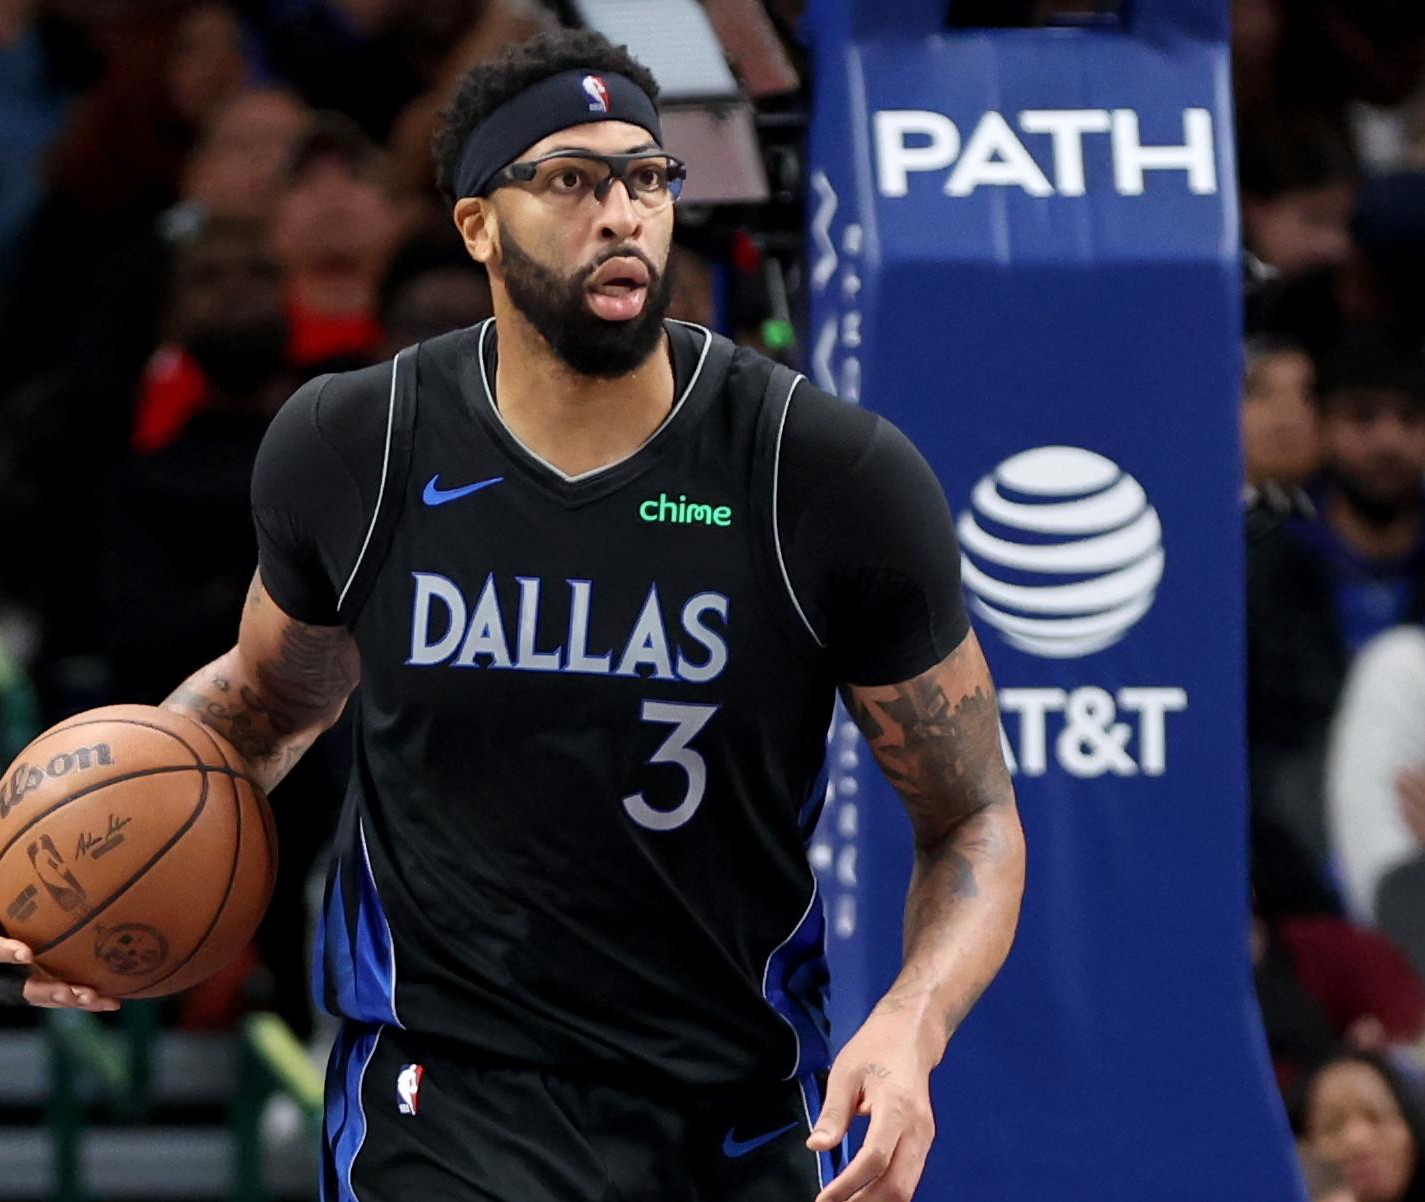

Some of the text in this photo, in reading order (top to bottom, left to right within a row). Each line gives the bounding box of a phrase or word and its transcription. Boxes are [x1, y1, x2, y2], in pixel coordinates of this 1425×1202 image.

[873, 108, 1217, 197] PATH
[639, 494, 732, 527] chime
[404, 571, 731, 684] DALLAS
[622, 699, 723, 832] 3
[999, 686, 1188, 777] T&T
